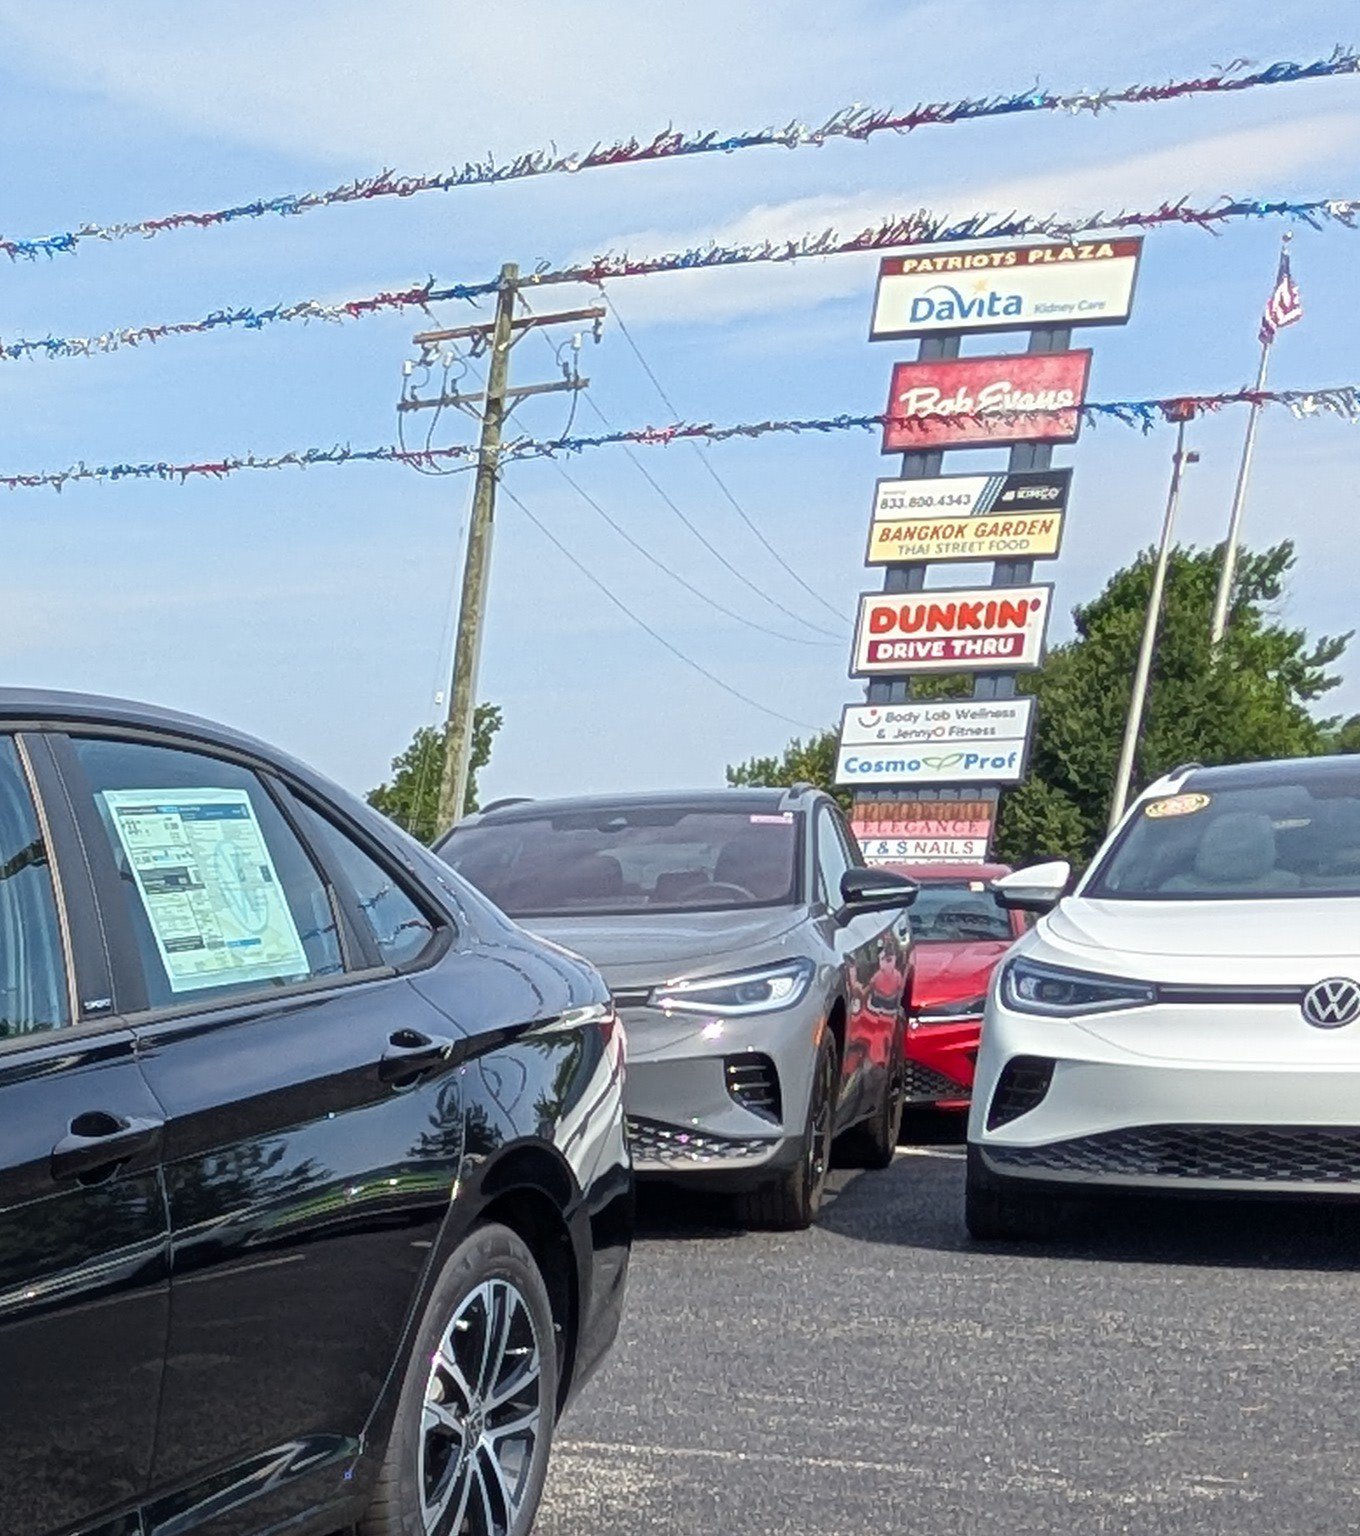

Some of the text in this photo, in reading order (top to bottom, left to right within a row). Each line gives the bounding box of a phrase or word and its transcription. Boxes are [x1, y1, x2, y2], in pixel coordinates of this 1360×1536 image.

[902, 243, 1115, 273] PATRIOTS PLAZA
[909, 285, 1106, 323] DaVita Kidney Care
[899, 381, 1074, 417] Bob Evans
[879, 518, 1055, 542] BANGKOK GARDEN
[897, 539, 1031, 557] THAI STREET FOOD
[876, 637, 1015, 659] DRIVE THRU
[885, 708, 1016, 724] Body Lab Wellness
[876, 729, 886, 739] &
[948, 725, 996, 737] Fitness
[844, 751, 1017, 774] Cosmo Prof
[862, 820, 979, 834] ELEGANCE
[861, 841, 974, 854] T & S NAILS
